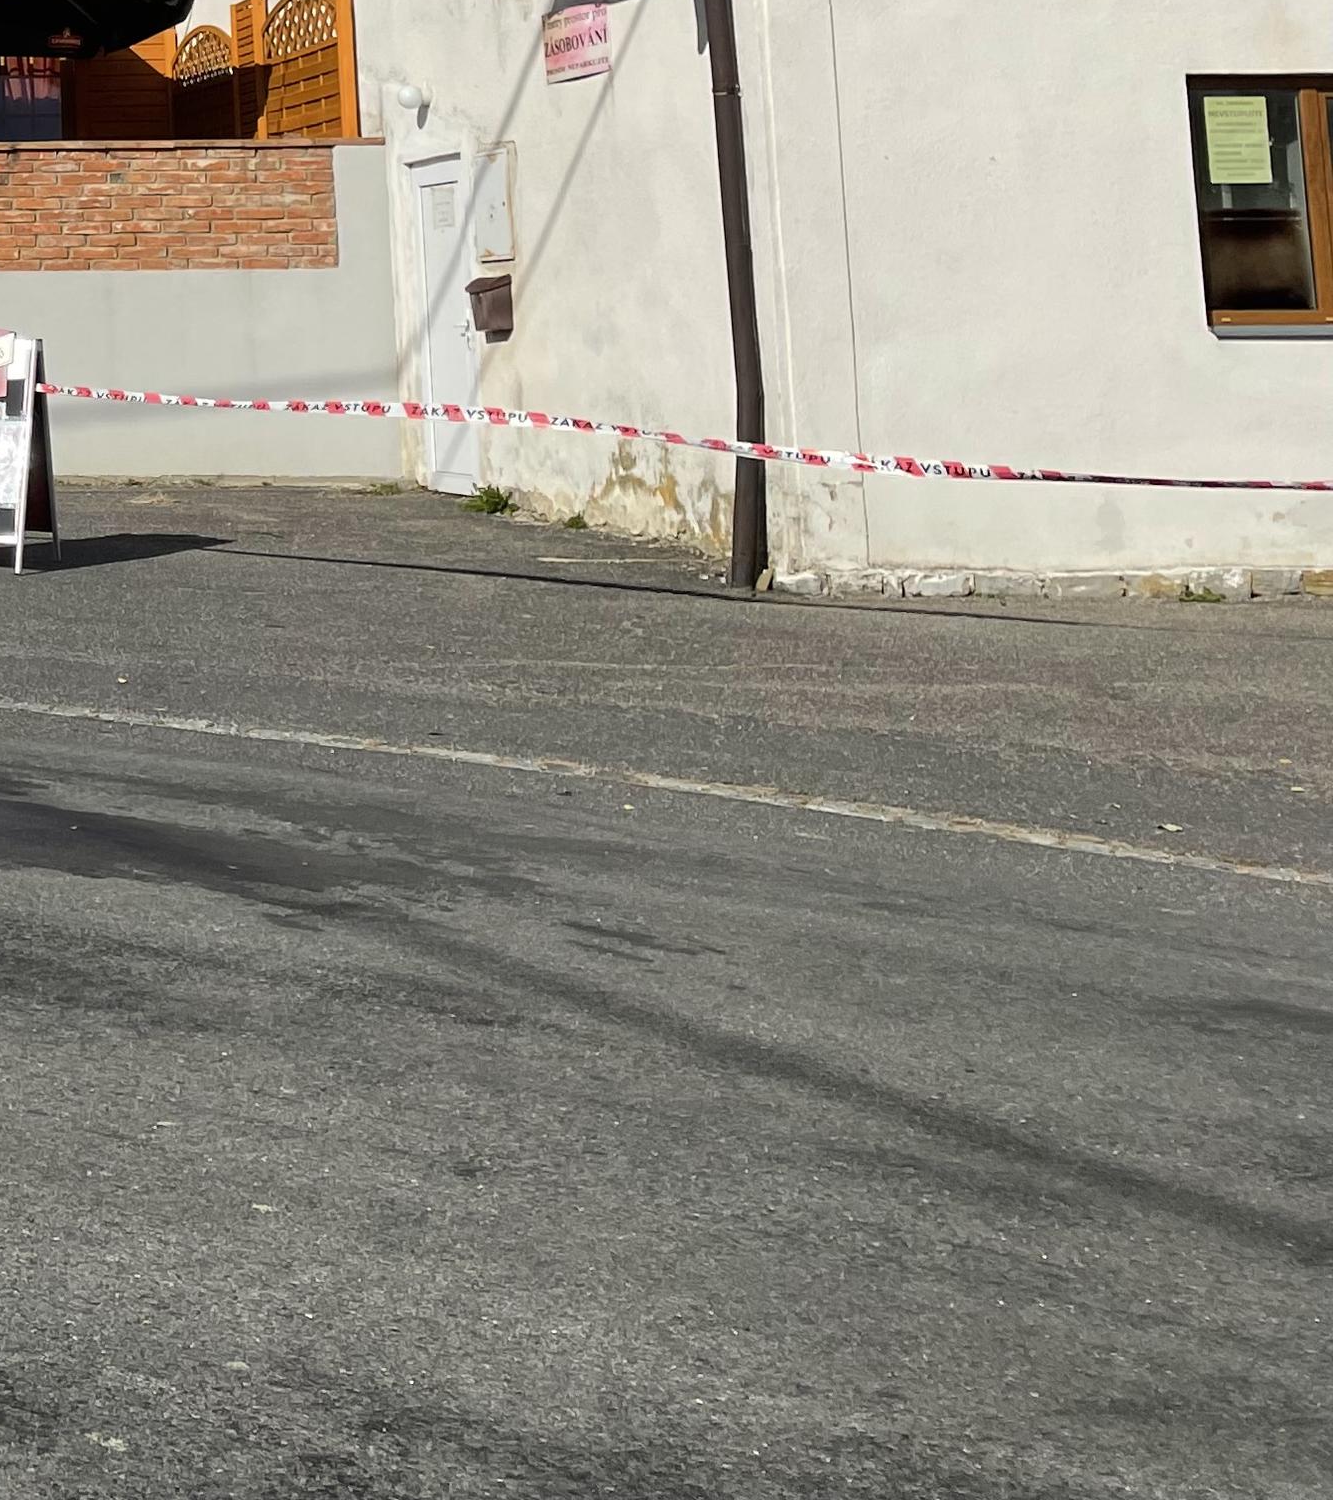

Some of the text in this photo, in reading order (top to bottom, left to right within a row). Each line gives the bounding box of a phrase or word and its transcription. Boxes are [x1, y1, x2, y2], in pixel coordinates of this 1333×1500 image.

[544, 23, 608, 58] ZÁSOBOVÁNÍ
[467, 408, 528, 423] VSTUPU
[921, 462, 991, 478] VSTUPU
